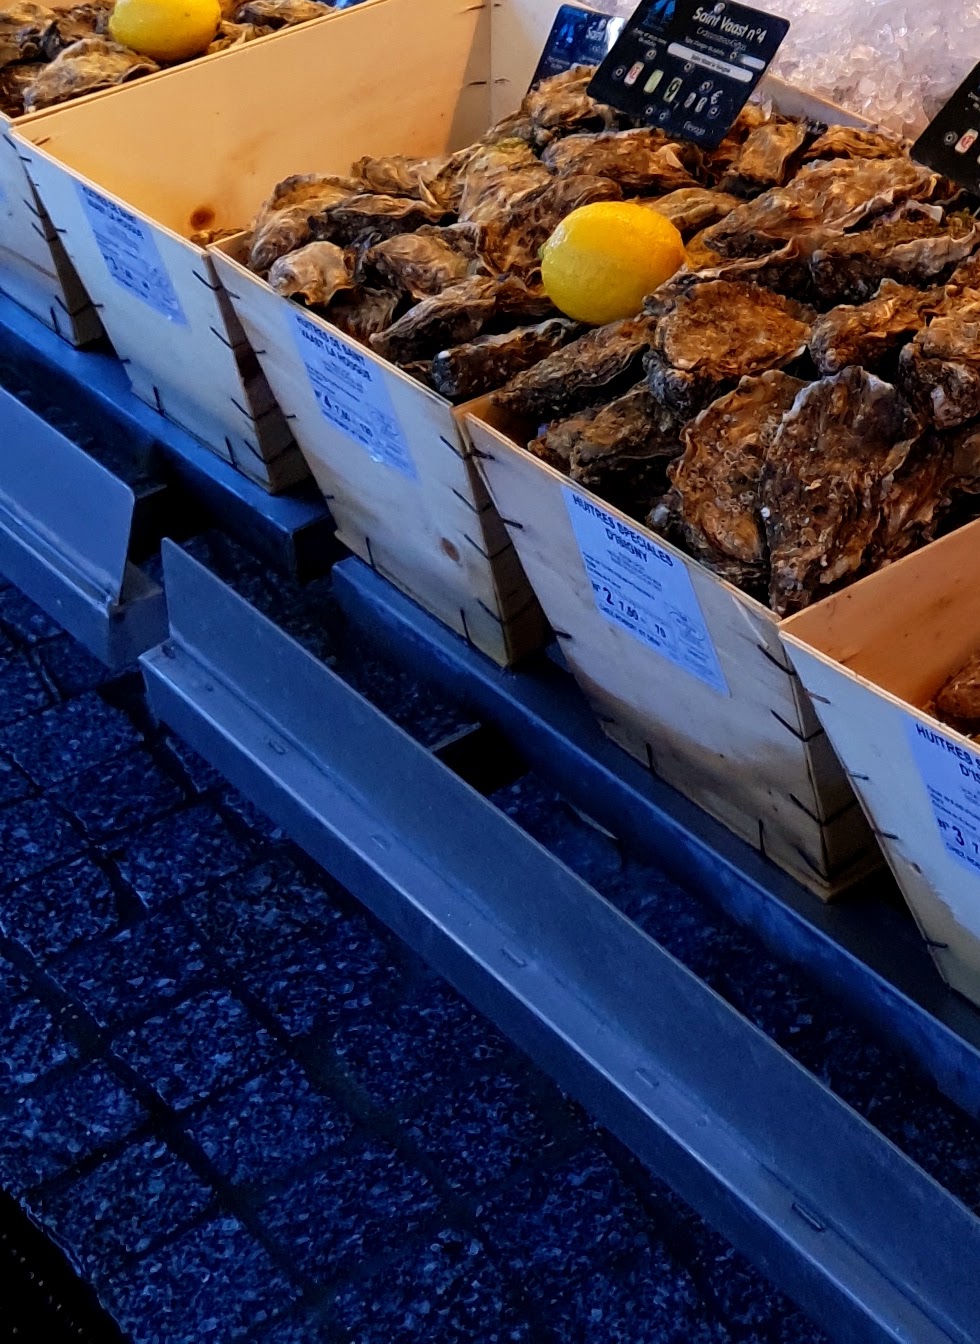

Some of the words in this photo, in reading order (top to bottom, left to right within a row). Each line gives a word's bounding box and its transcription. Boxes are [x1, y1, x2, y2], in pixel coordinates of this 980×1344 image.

[692, 6, 721, 27] Saint
[720, 15, 749, 38] Vaast
[746, 27, 767, 44] n°4
[602, 586, 615, 606] 2
[915, 722, 974, 766] HUITRES
[951, 825, 965, 847] 3
